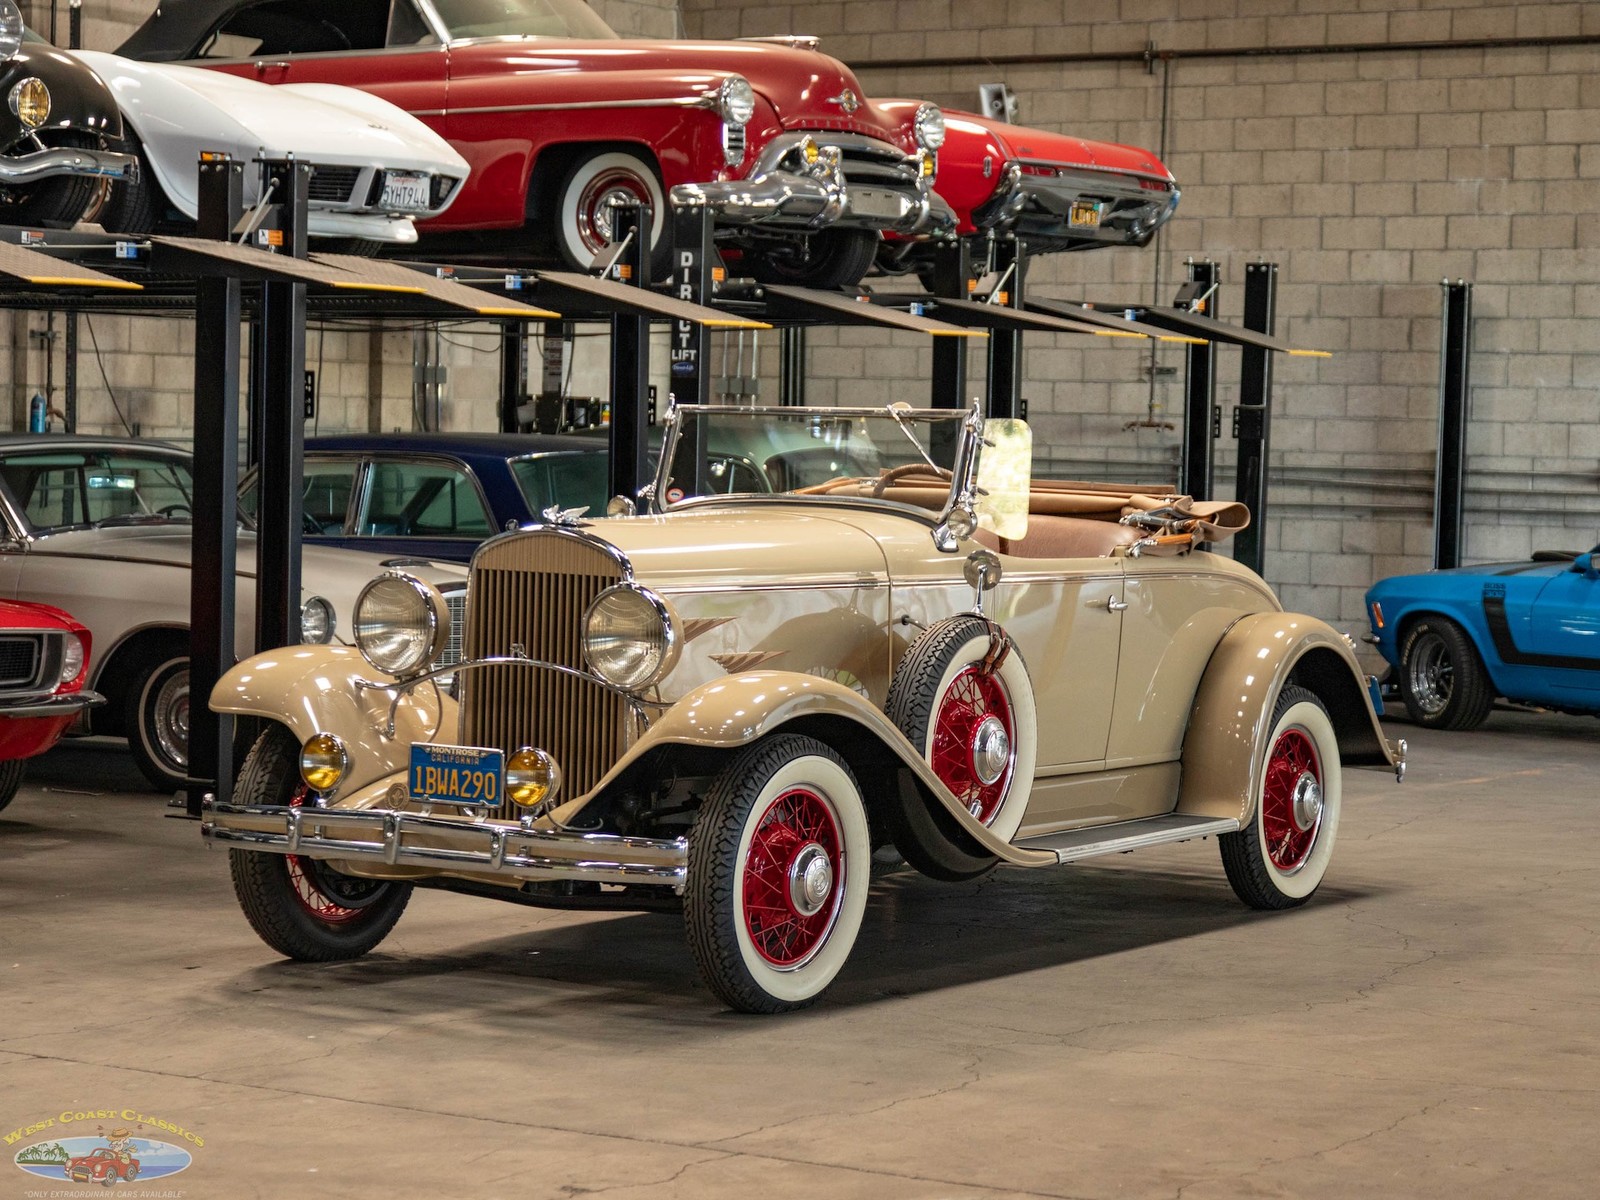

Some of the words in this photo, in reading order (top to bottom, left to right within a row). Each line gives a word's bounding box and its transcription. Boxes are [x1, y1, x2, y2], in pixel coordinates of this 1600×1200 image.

[383, 185, 426, 206] 5YHT944
[679, 251, 693, 348] DIRCT
[672, 349, 697, 360] LIFT
[431, 746, 480, 757] MONTROSE
[431, 753, 480, 766] CALIFORNIA
[413, 766, 497, 800] 1BWA290
